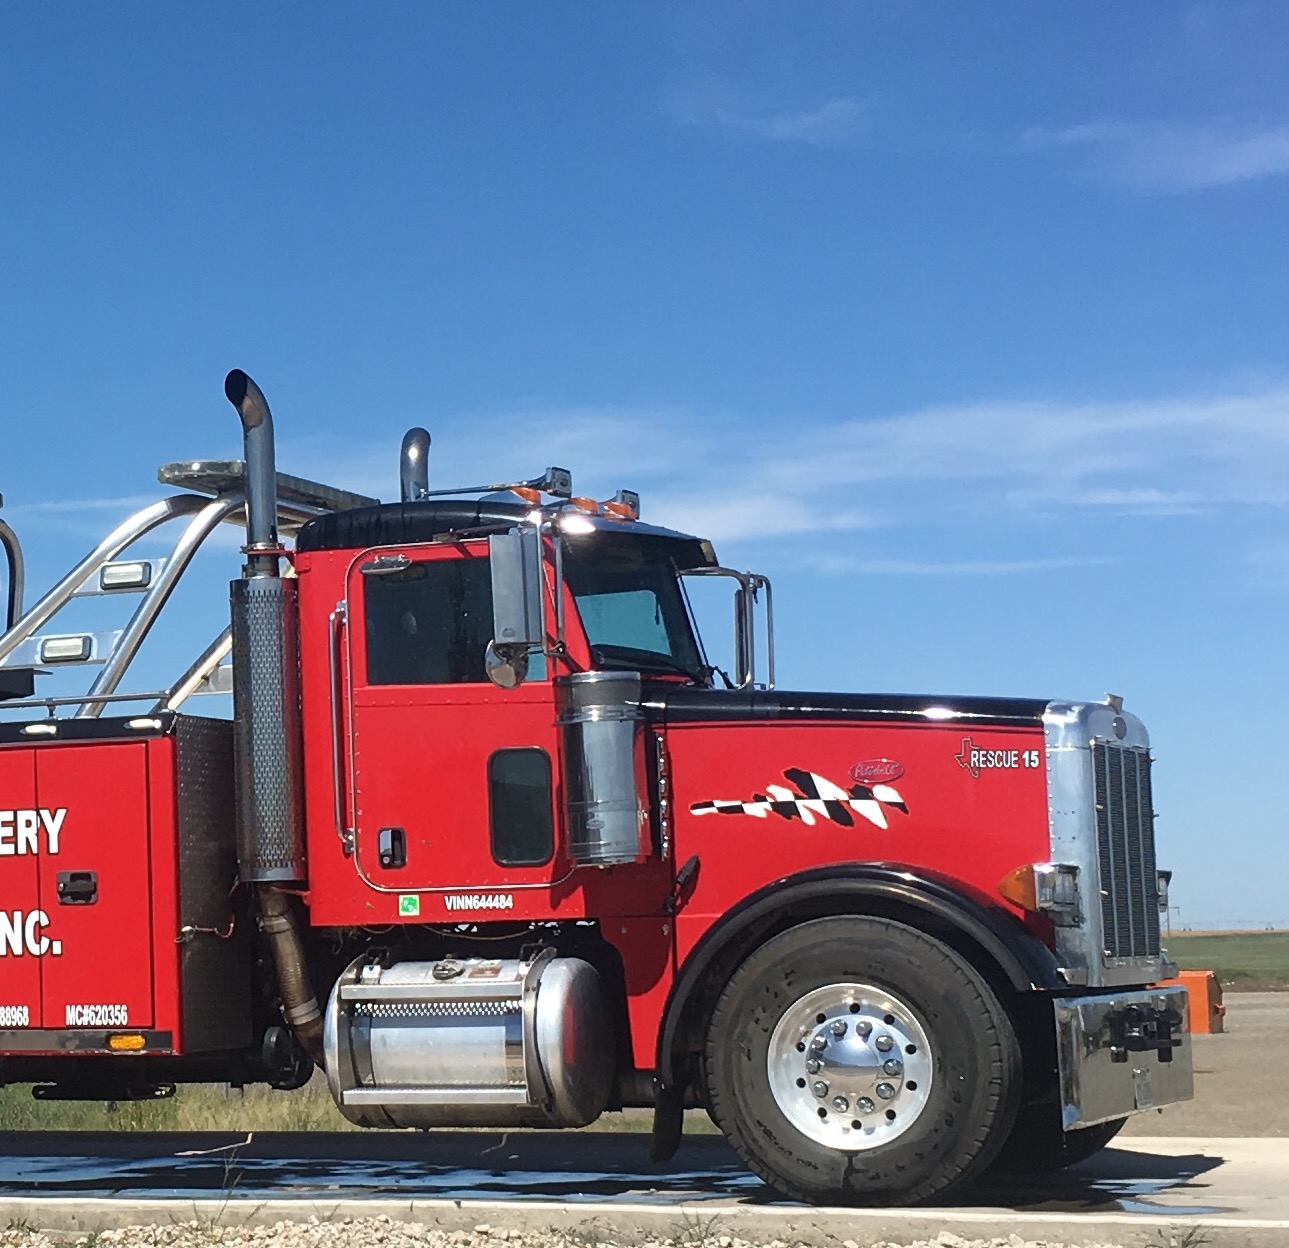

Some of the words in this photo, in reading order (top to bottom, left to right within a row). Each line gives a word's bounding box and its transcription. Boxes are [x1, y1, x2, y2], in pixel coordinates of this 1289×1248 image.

[970, 750, 1019, 768] RESCUE
[1022, 750, 1039, 768] 15
[444, 894, 514, 911] VINN644484
[65, 1004, 128, 1027] MC#620356
